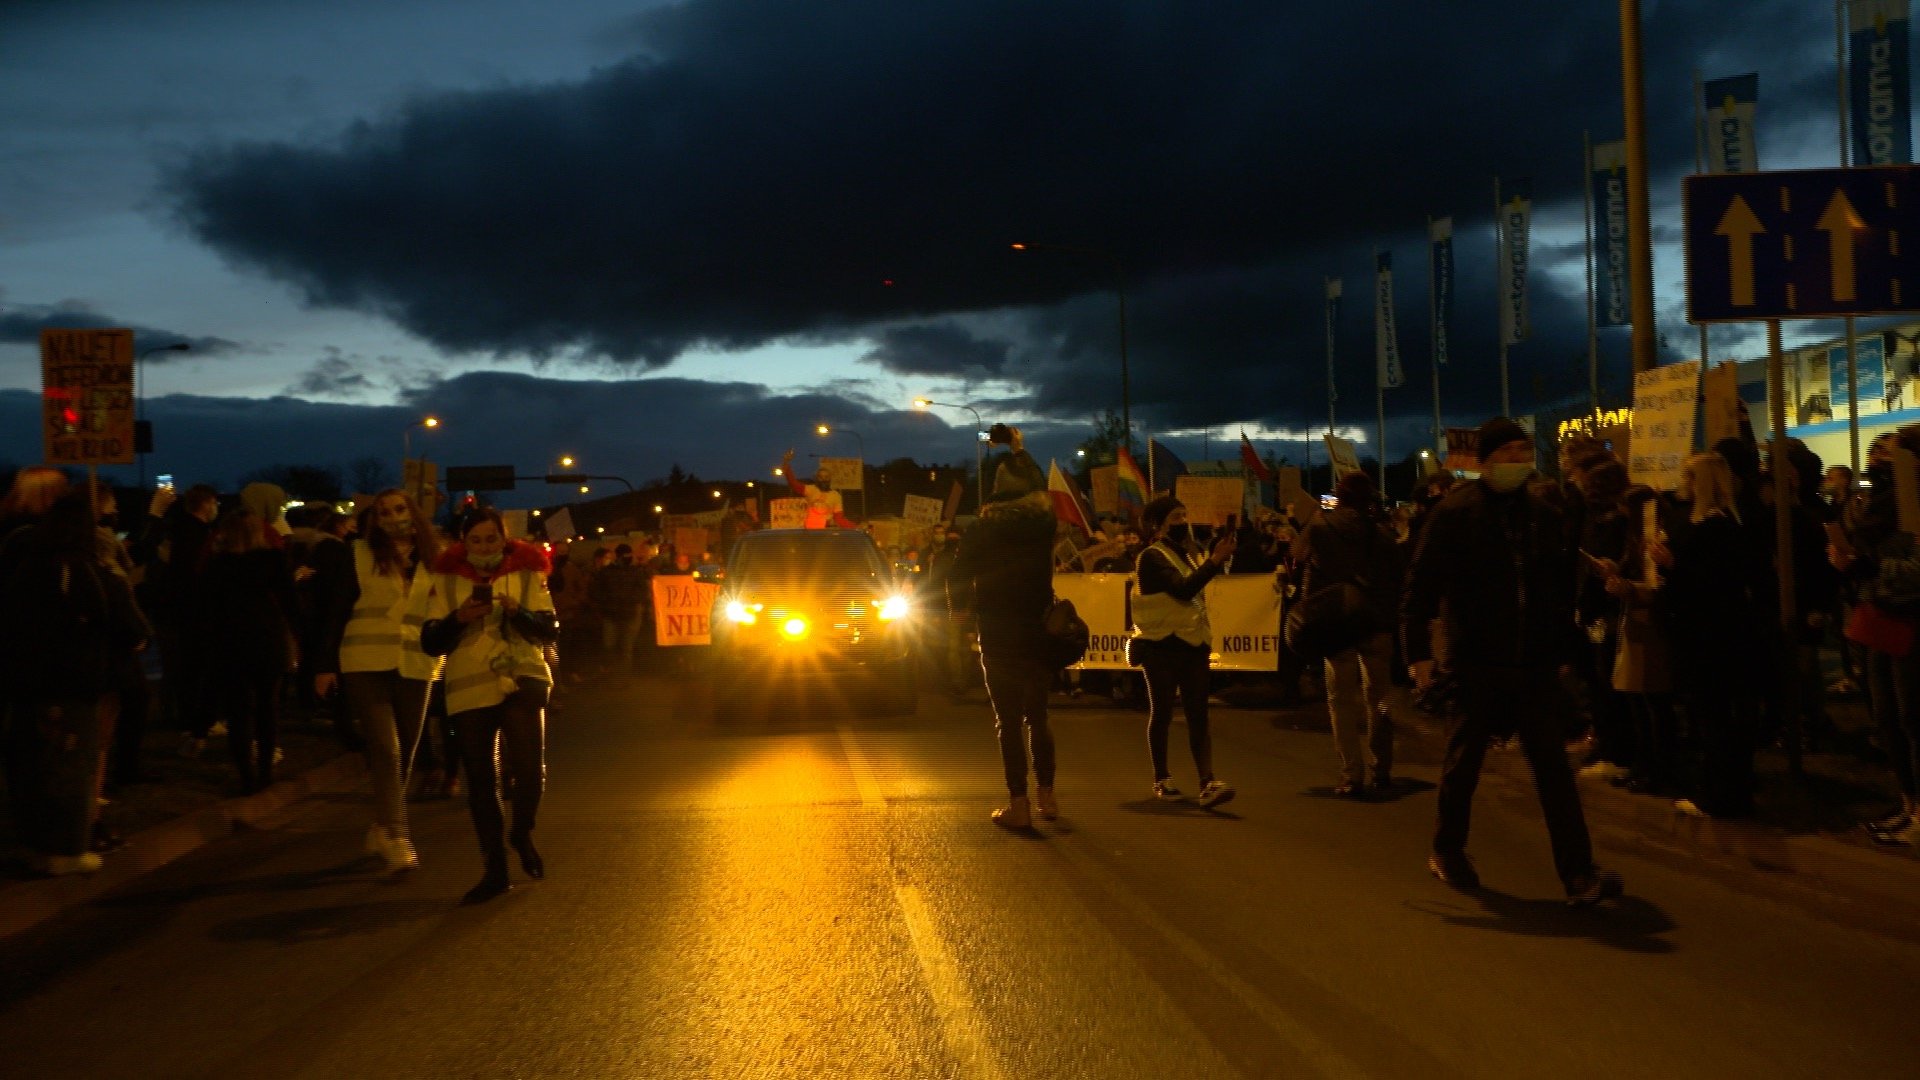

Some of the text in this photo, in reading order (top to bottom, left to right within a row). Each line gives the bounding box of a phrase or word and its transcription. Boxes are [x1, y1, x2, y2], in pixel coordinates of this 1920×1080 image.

[1510, 212, 1524, 340] castorama
[1607, 177, 1625, 324] castorama
[1380, 280, 1398, 386] castorama
[666, 614, 709, 635] NIE
[1223, 635, 1279, 652] KOBIET
